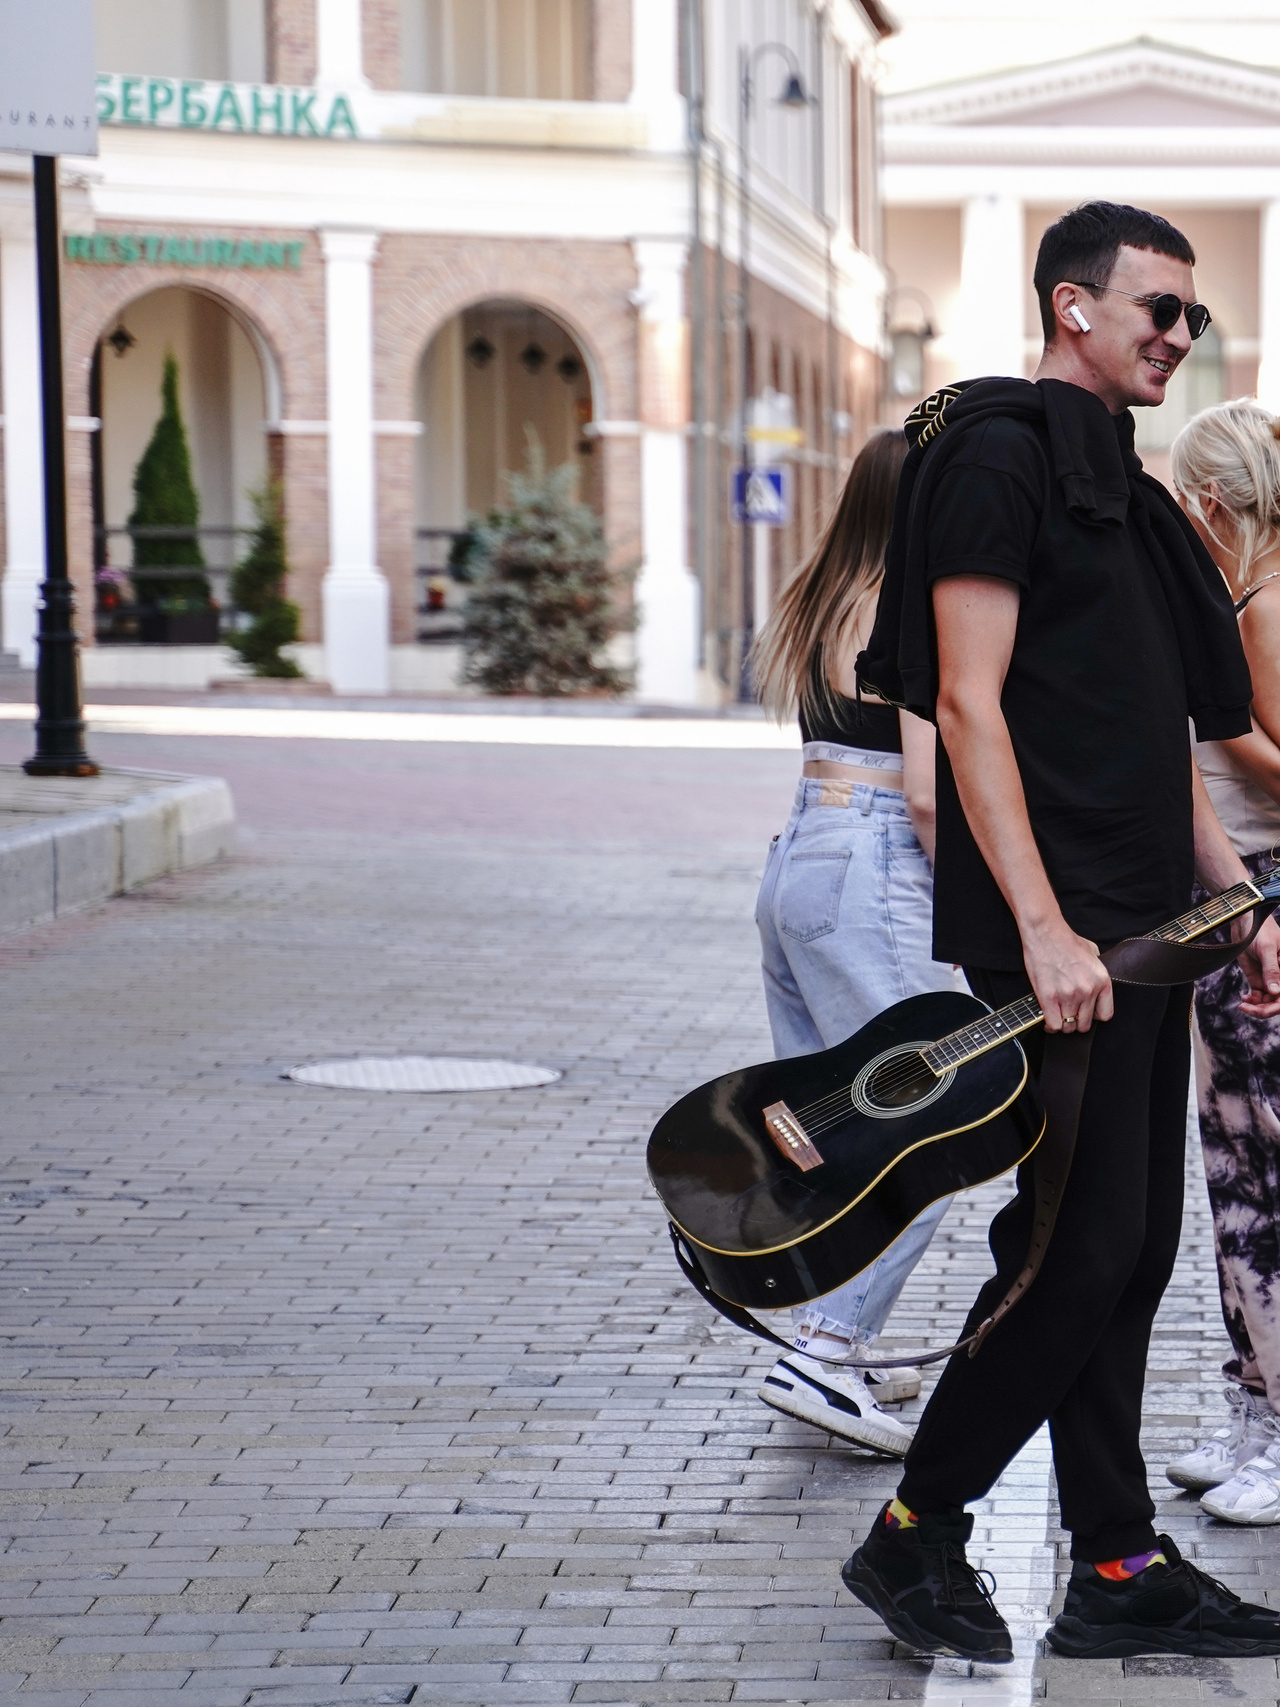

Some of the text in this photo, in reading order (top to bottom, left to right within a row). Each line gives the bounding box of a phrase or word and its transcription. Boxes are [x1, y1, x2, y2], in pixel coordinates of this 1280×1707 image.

[0, 109, 91, 131] URANT
[65, 233, 303, 268] RESTAURANT
[826, 747, 847, 762] NIKE
[860, 755, 888, 769] NIKE
